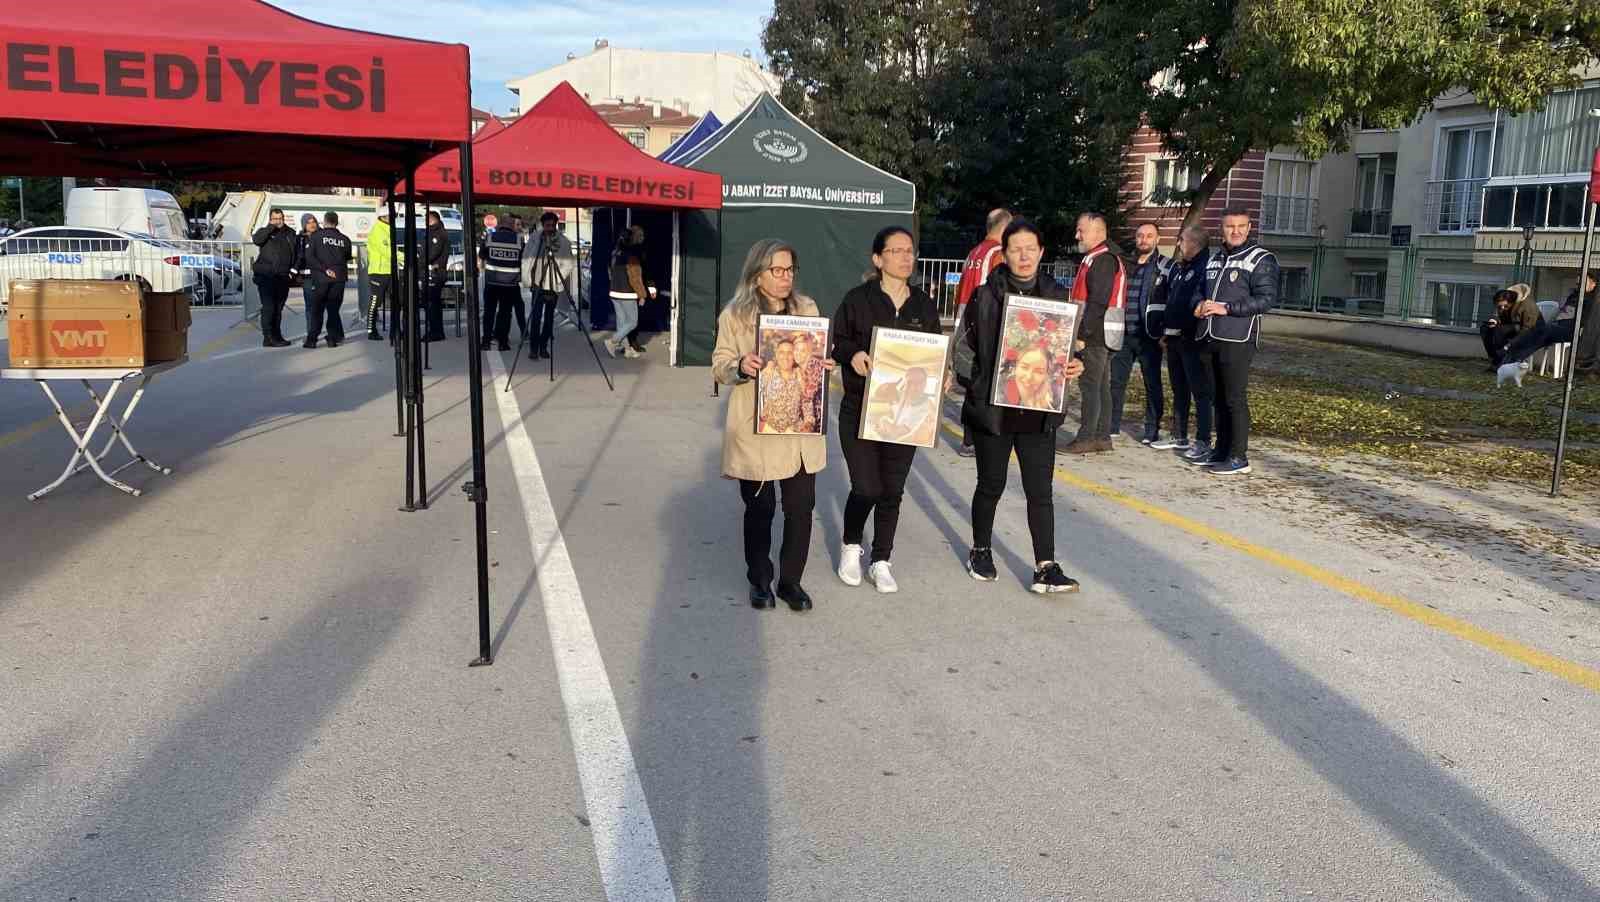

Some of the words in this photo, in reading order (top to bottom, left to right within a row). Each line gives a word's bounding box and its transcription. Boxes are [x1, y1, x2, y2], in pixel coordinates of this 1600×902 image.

[0, 42, 386, 113] ELEDİYESİ
[438, 167, 480, 184] T..
[489, 170, 551, 188] BOLU
[560, 173, 694, 200] BELEDİYESİ
[731, 184, 761, 197] ABANT
[763, 183, 788, 197] İZZET
[790, 185, 823, 201] BAYSAL
[825, 186, 884, 204] ÜNİVERSİTESİ
[52, 330, 109, 348] YMT
